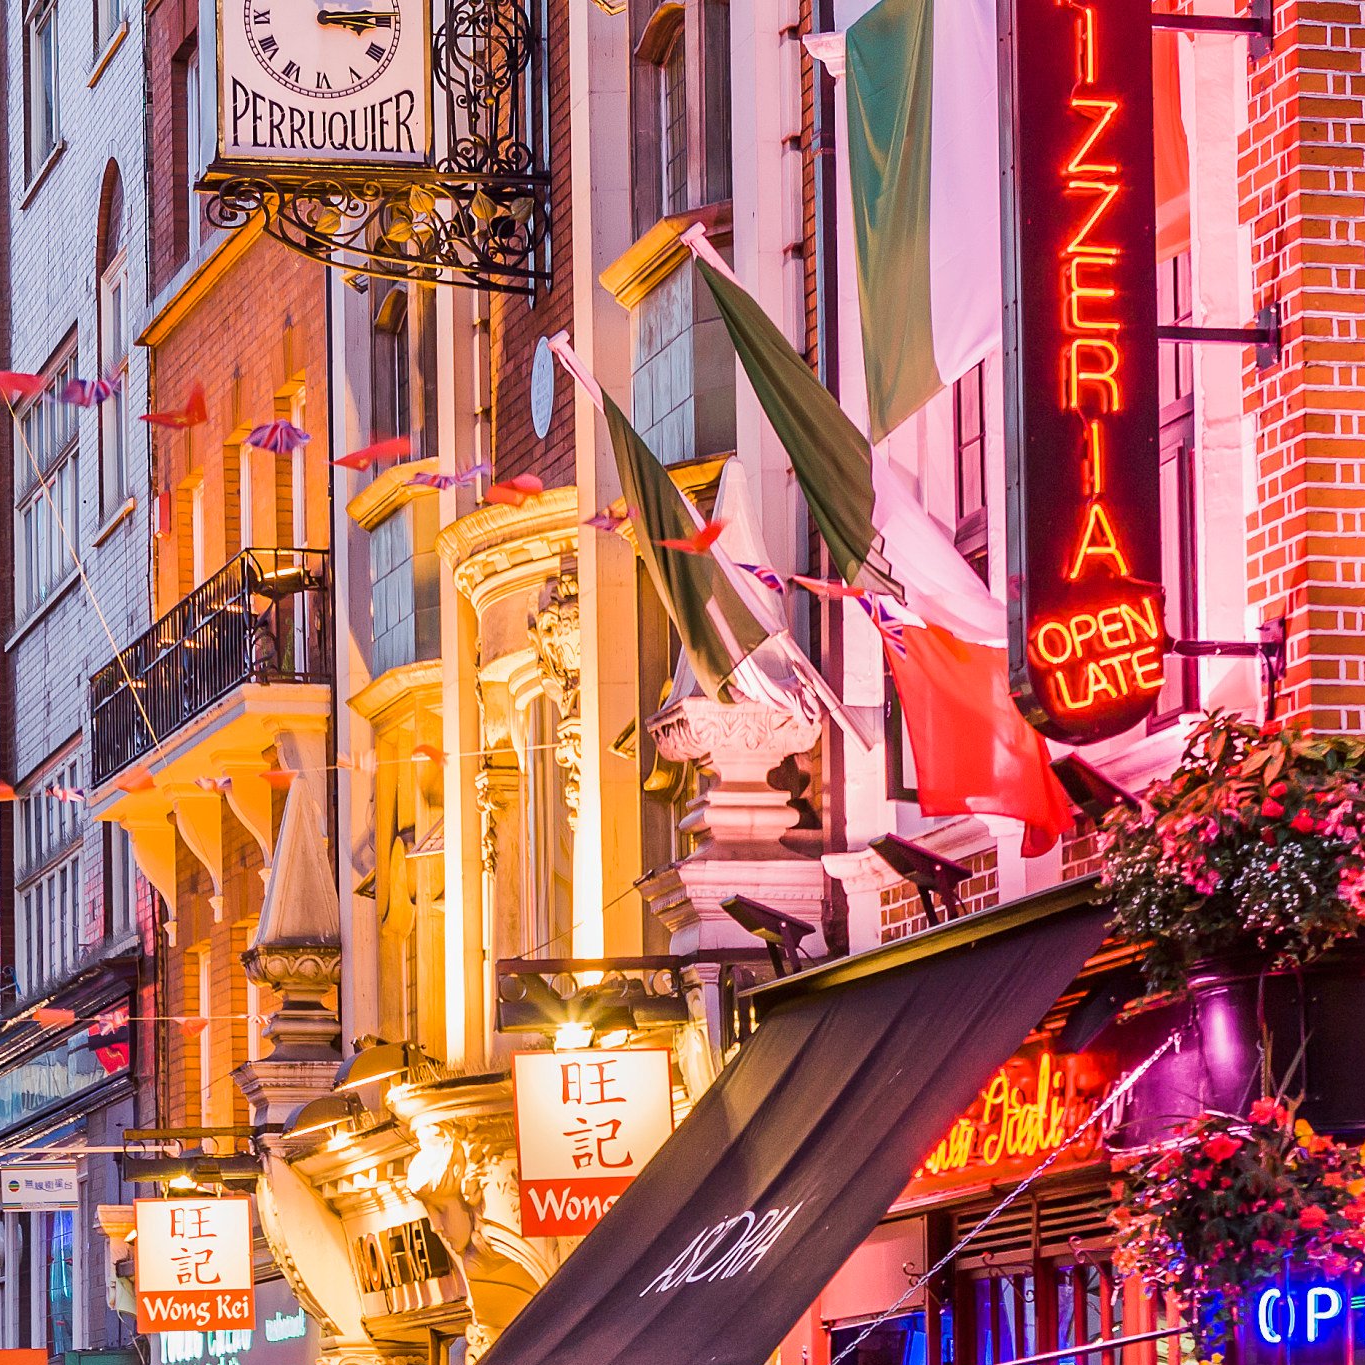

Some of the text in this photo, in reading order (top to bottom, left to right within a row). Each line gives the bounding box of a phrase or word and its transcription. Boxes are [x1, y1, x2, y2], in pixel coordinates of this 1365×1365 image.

[231, 75, 416, 154] PERRUQUIER
[1067, 6, 1129, 579] IZZERIA
[1034, 595, 1160, 665] OPEN
[1055, 645, 1165, 710] LATE
[560, 1059, 634, 1171] 旺記
[169, 1205, 222, 1286] 旺記
[142, 1294, 250, 1327] Wong Kei
